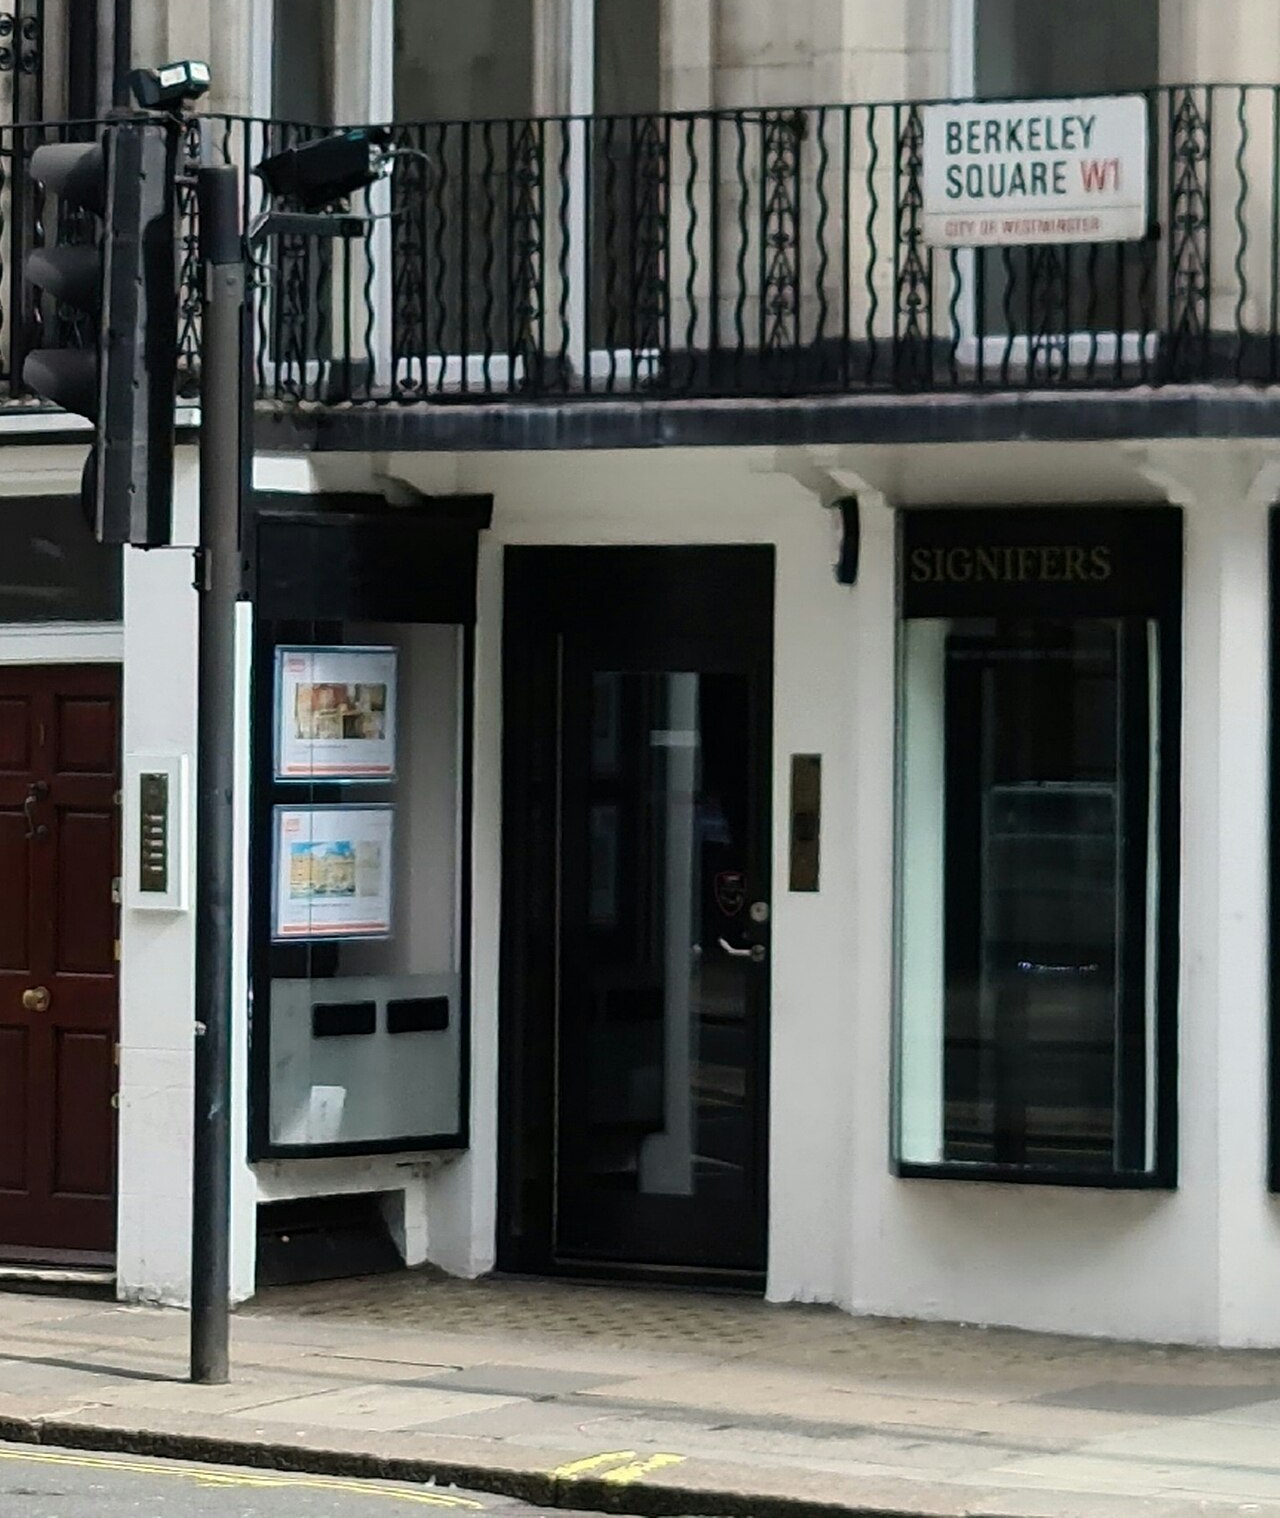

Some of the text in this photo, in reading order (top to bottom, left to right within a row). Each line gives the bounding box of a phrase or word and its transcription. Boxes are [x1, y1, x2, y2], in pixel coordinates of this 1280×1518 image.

[945, 115, 1096, 155] BERKELEY
[945, 158, 1121, 198] SQUARE W1
[945, 220, 976, 236] CITY
[911, 547, 1111, 582] SIGNIFERS
